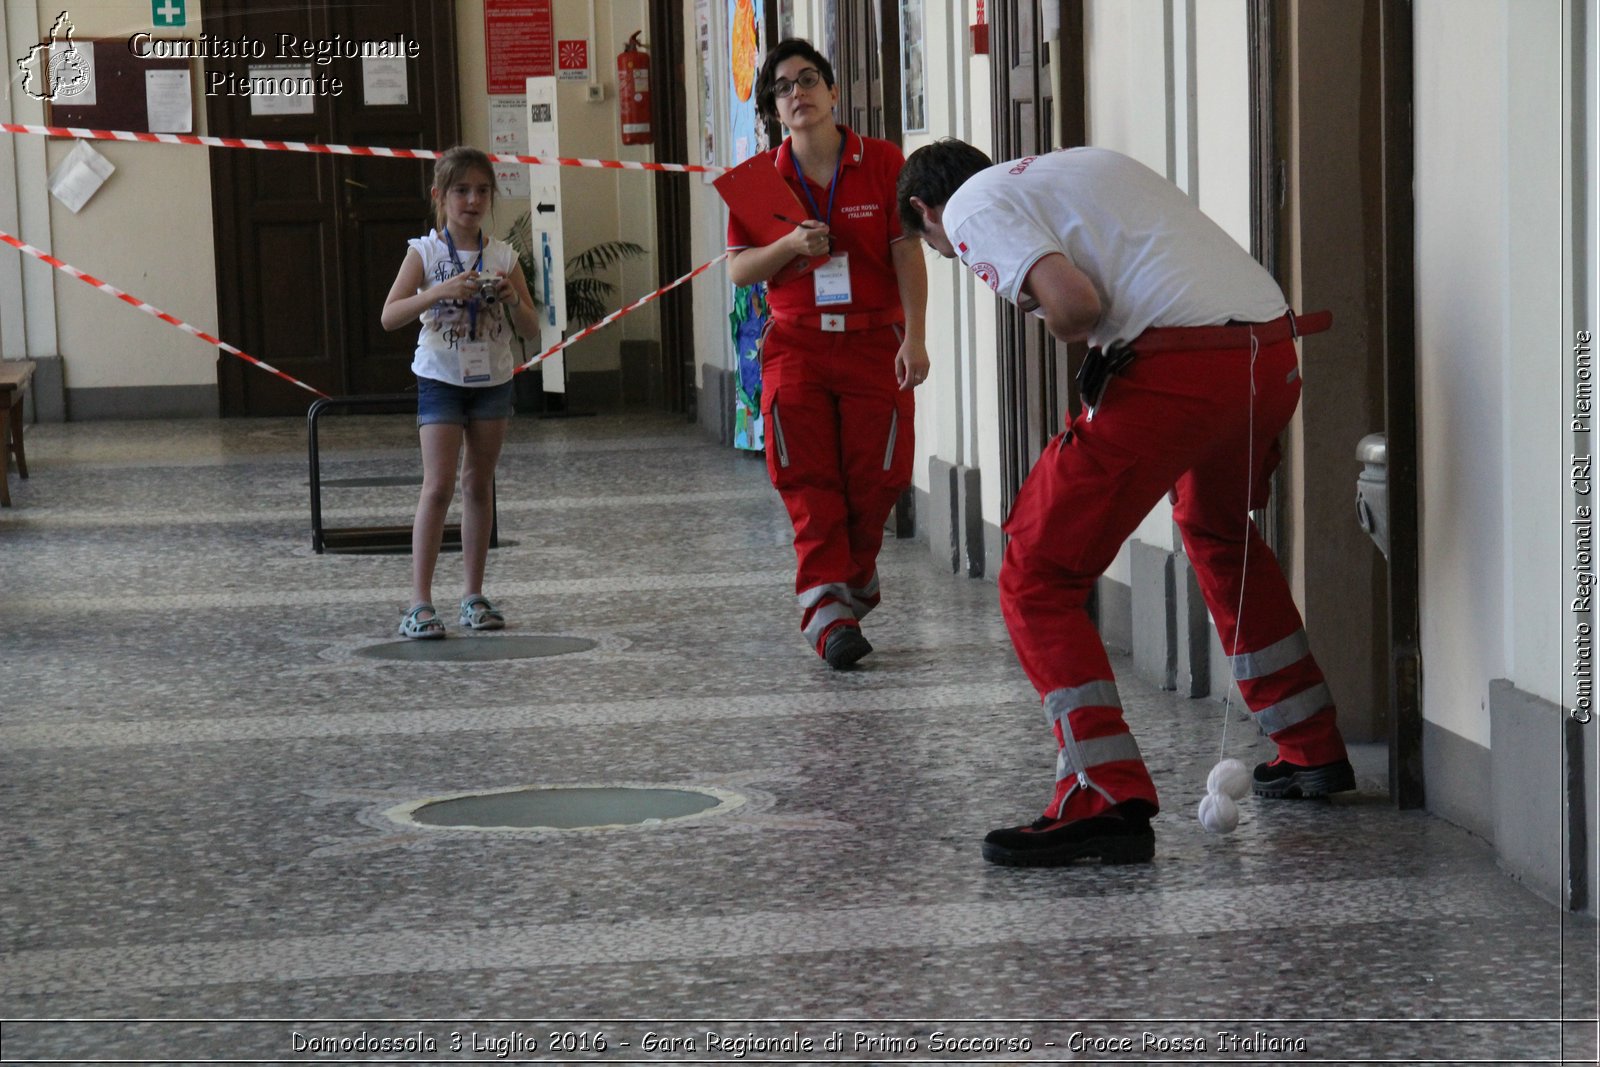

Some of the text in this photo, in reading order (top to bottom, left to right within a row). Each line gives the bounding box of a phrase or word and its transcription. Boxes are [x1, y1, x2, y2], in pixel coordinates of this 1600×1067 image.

[841, 203, 880, 213] CROCE ROSSA
[848, 211, 873, 219] ITALIANA
